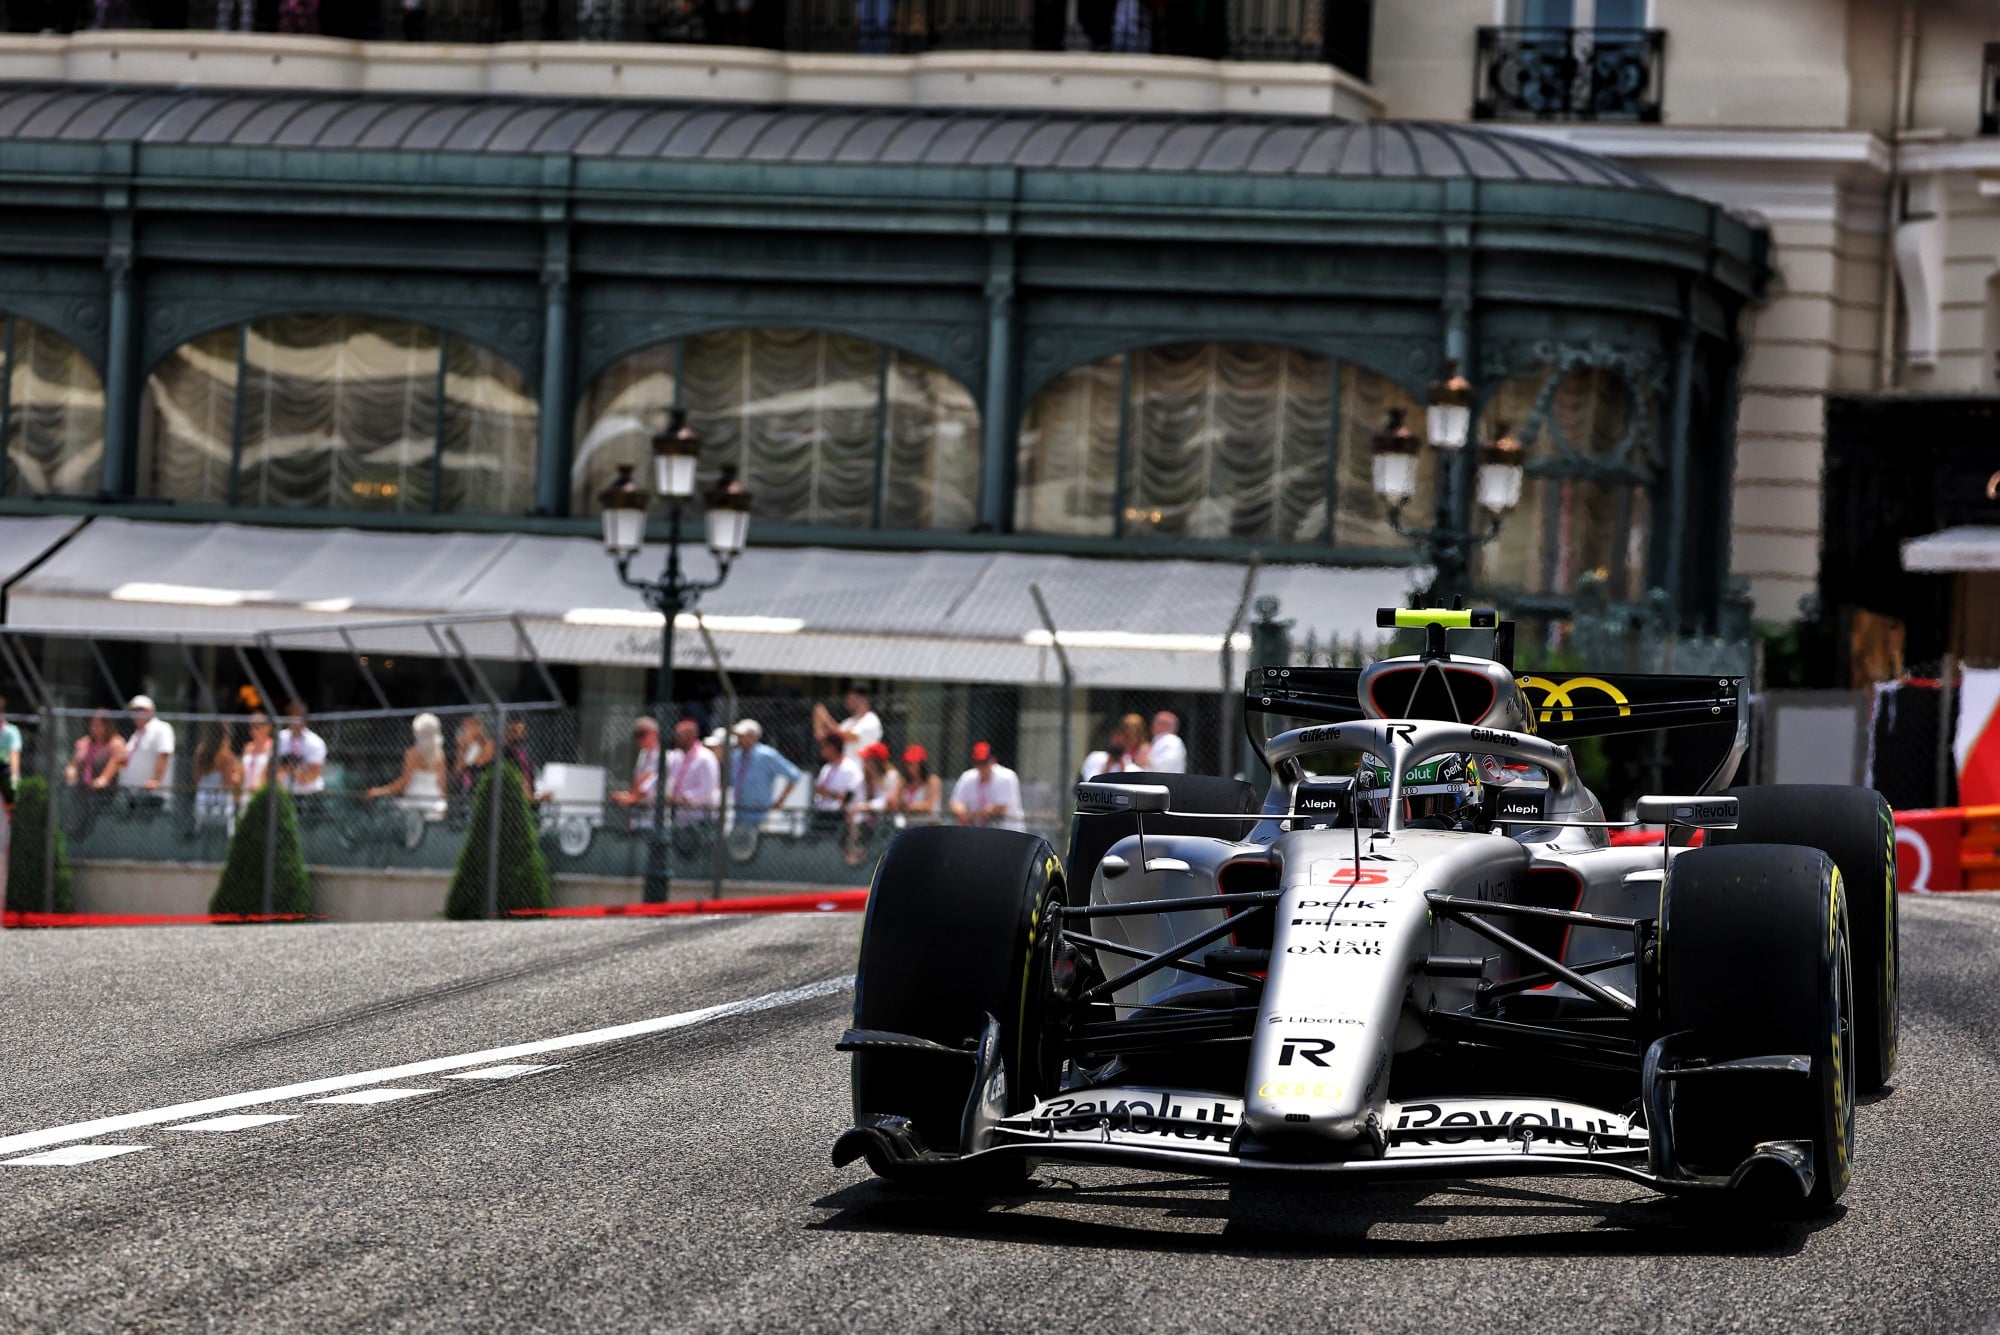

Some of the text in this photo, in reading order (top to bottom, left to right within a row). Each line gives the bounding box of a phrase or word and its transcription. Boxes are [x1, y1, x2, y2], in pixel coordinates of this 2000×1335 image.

[1298, 726, 1341, 744] Gillette
[1470, 728, 1519, 747] Gillette
[1383, 768, 1432, 783] Rolut
[1301, 799, 1336, 810] Aleph
[1502, 803, 1539, 815] Aleph
[1327, 867, 1390, 886] 5
[1291, 917, 1388, 929] PIRELLI
[1286, 945, 1382, 956] QATAR
[1289, 1015, 1366, 1028] Libertex
[1040, 1092, 1235, 1142] Revolut
[1391, 1103, 1617, 1150] Revolut
